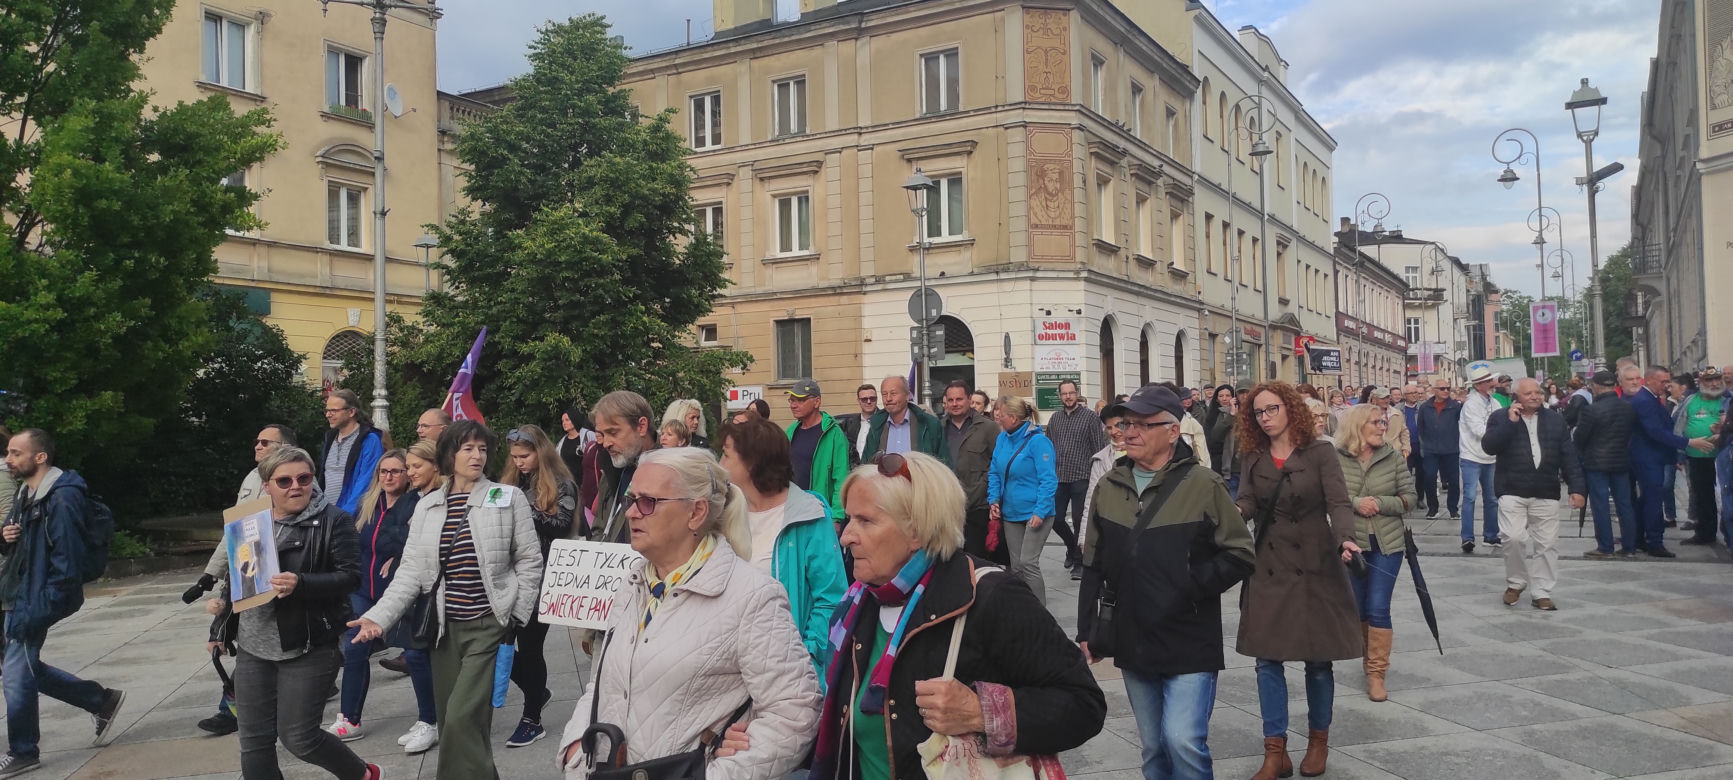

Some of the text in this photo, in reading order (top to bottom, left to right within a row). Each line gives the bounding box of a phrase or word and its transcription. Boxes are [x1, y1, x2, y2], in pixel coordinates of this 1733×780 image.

[1042, 320, 1071, 330] Salon
[1037, 331, 1077, 341] obuwia
[741, 389, 760, 400] Pru
[548, 547, 589, 567] JEST
[548, 571, 591, 589] JEDNA
[539, 589, 589, 620] ŚWIECKIE
[337, 726, 348, 736] N
